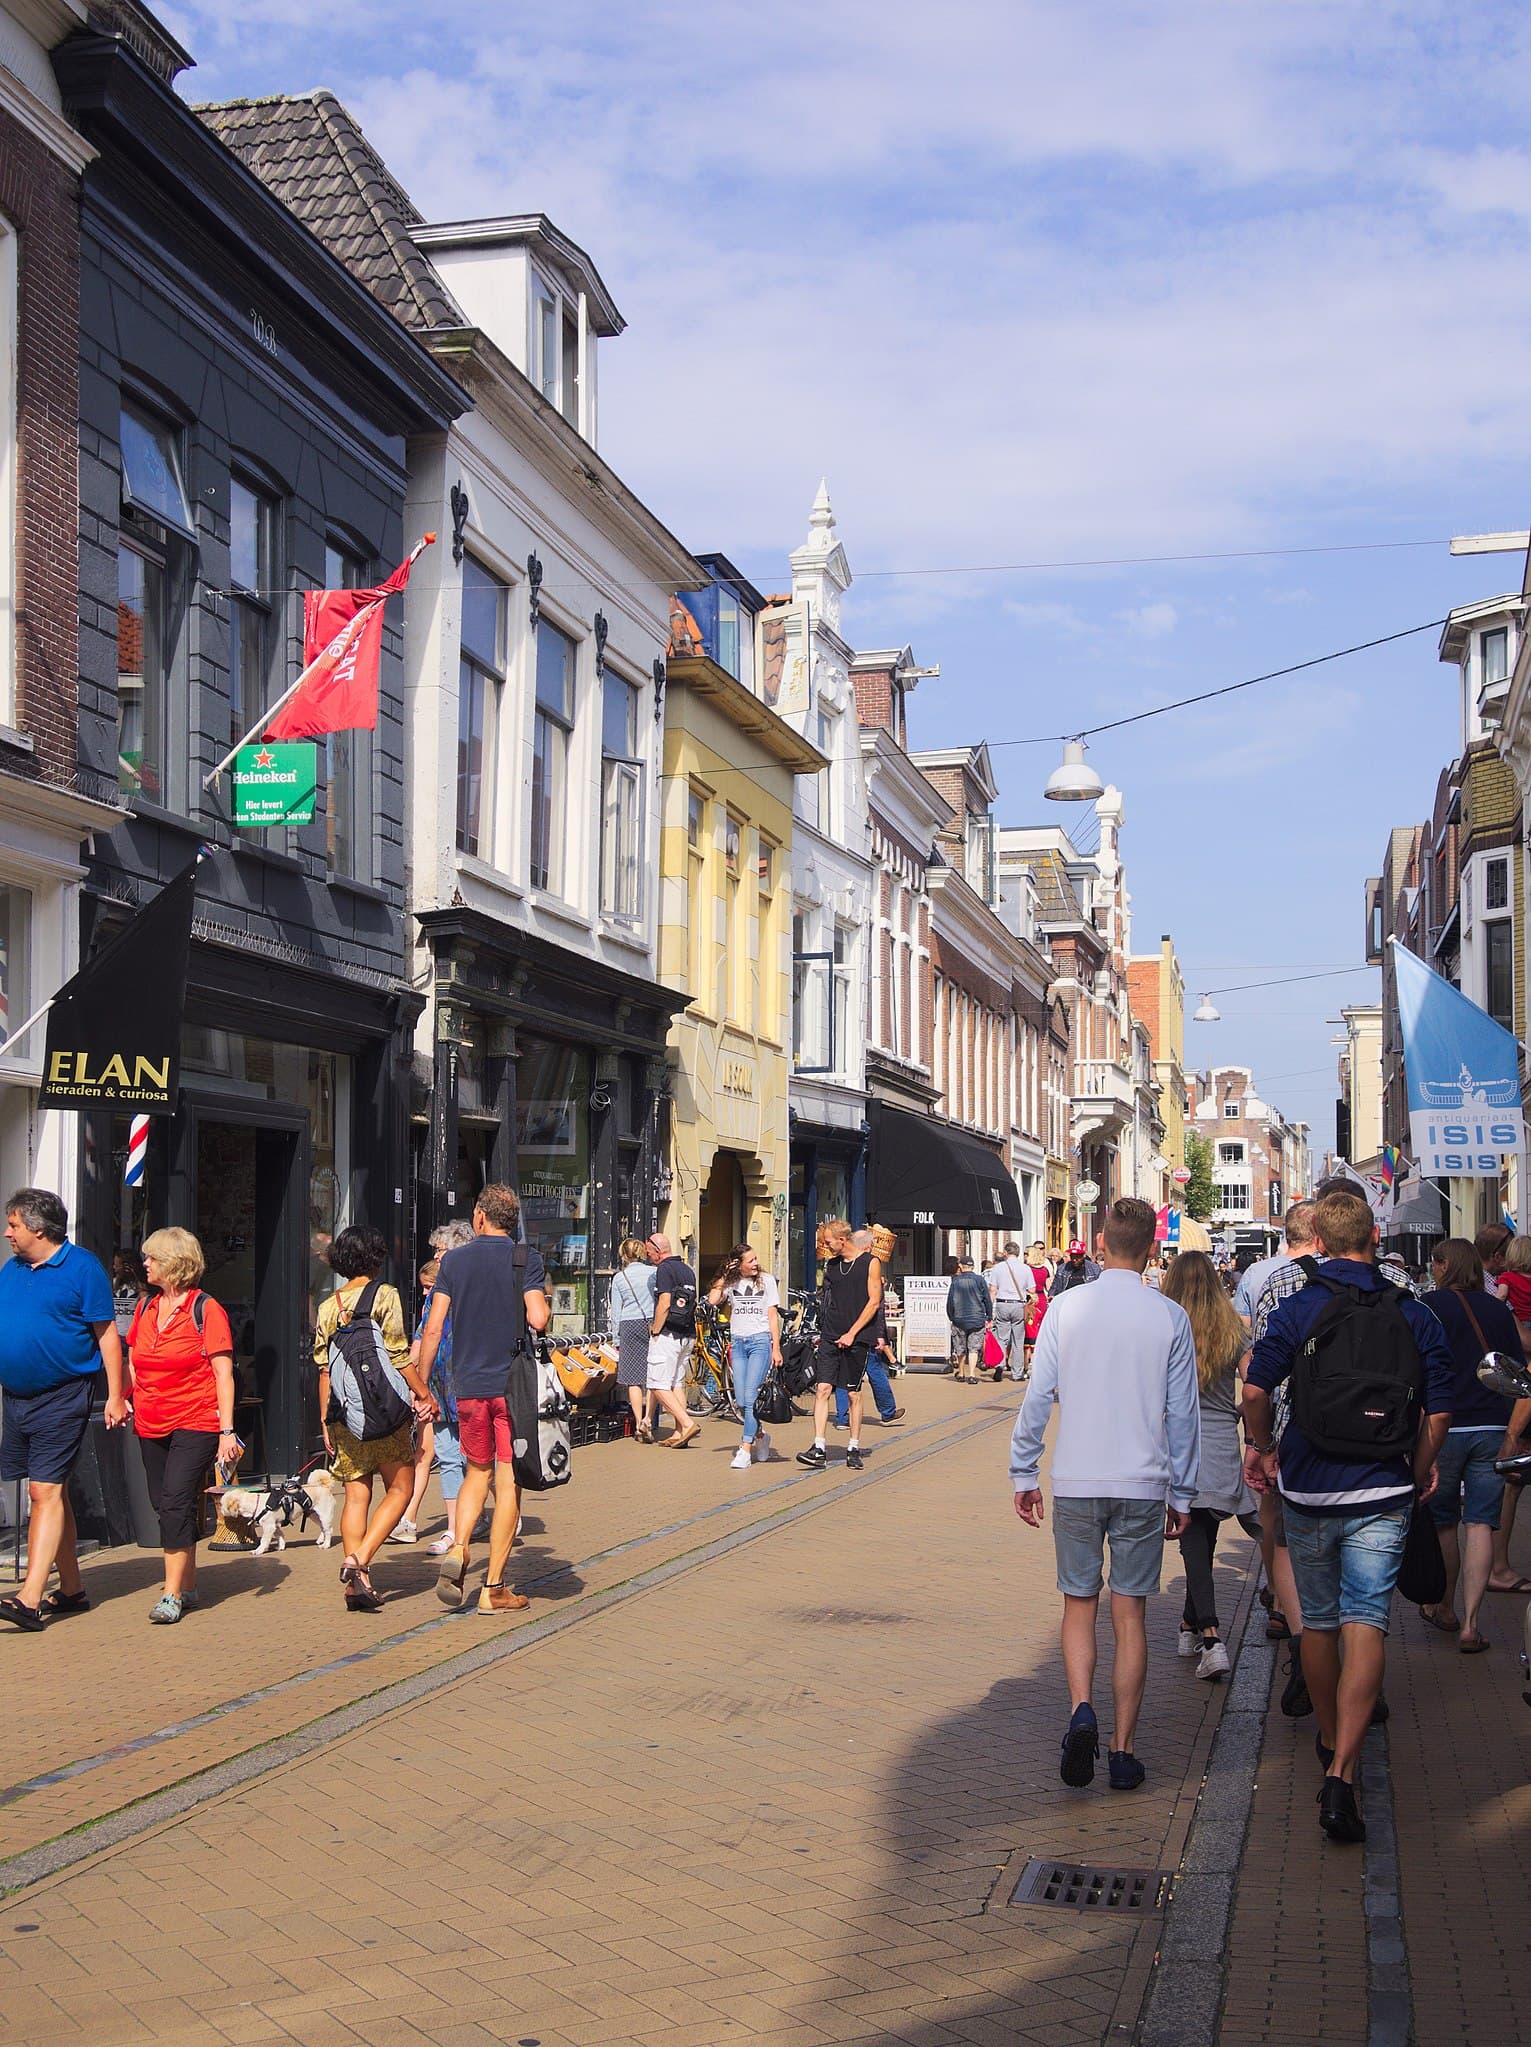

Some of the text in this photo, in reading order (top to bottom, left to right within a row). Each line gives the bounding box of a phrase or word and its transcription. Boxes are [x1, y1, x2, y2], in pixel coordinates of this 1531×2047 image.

[232, 770, 296, 784] Heineken
[245, 800, 260, 809] Hier
[286, 811, 312, 820] Service
[48, 1051, 170, 1089] ELAN
[45, 1083, 168, 1101] sieraden & curiosa
[1428, 1112, 1515, 1123] antiquariaat
[1429, 1124, 1517, 1145] ISIS
[1434, 1154, 1497, 1170] ISIS
[913, 1211, 935, 1224] FOLK
[1409, 1223, 1435, 1232] FRIS!
[908, 1280, 949, 1289] TERRAS
[734, 1306, 763, 1315] adidas
